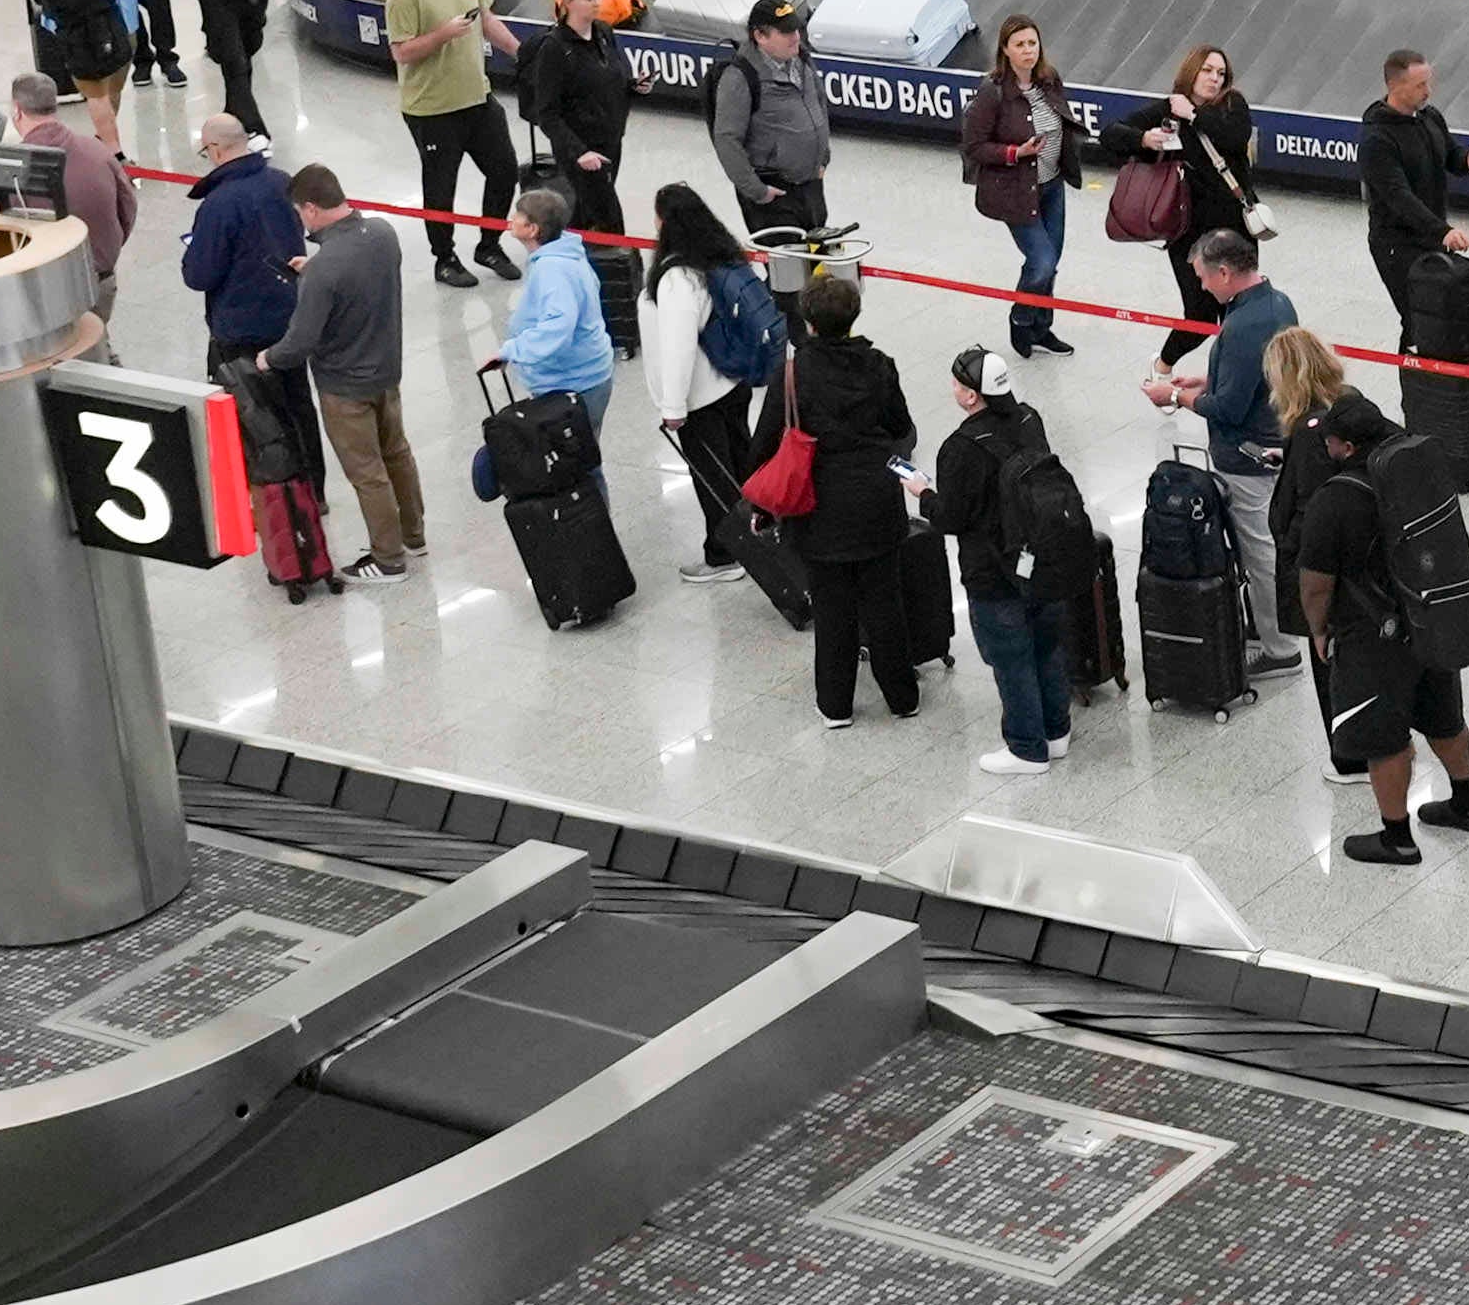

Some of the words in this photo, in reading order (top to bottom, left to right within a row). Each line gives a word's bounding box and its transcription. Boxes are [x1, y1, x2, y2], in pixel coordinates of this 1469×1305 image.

[625, 47, 696, 88] YOUR
[899, 80, 954, 120] BAG
[1116, 309, 1133, 320] ATL
[1402, 357, 1422, 369] ATL
[78, 412, 173, 545] 3
